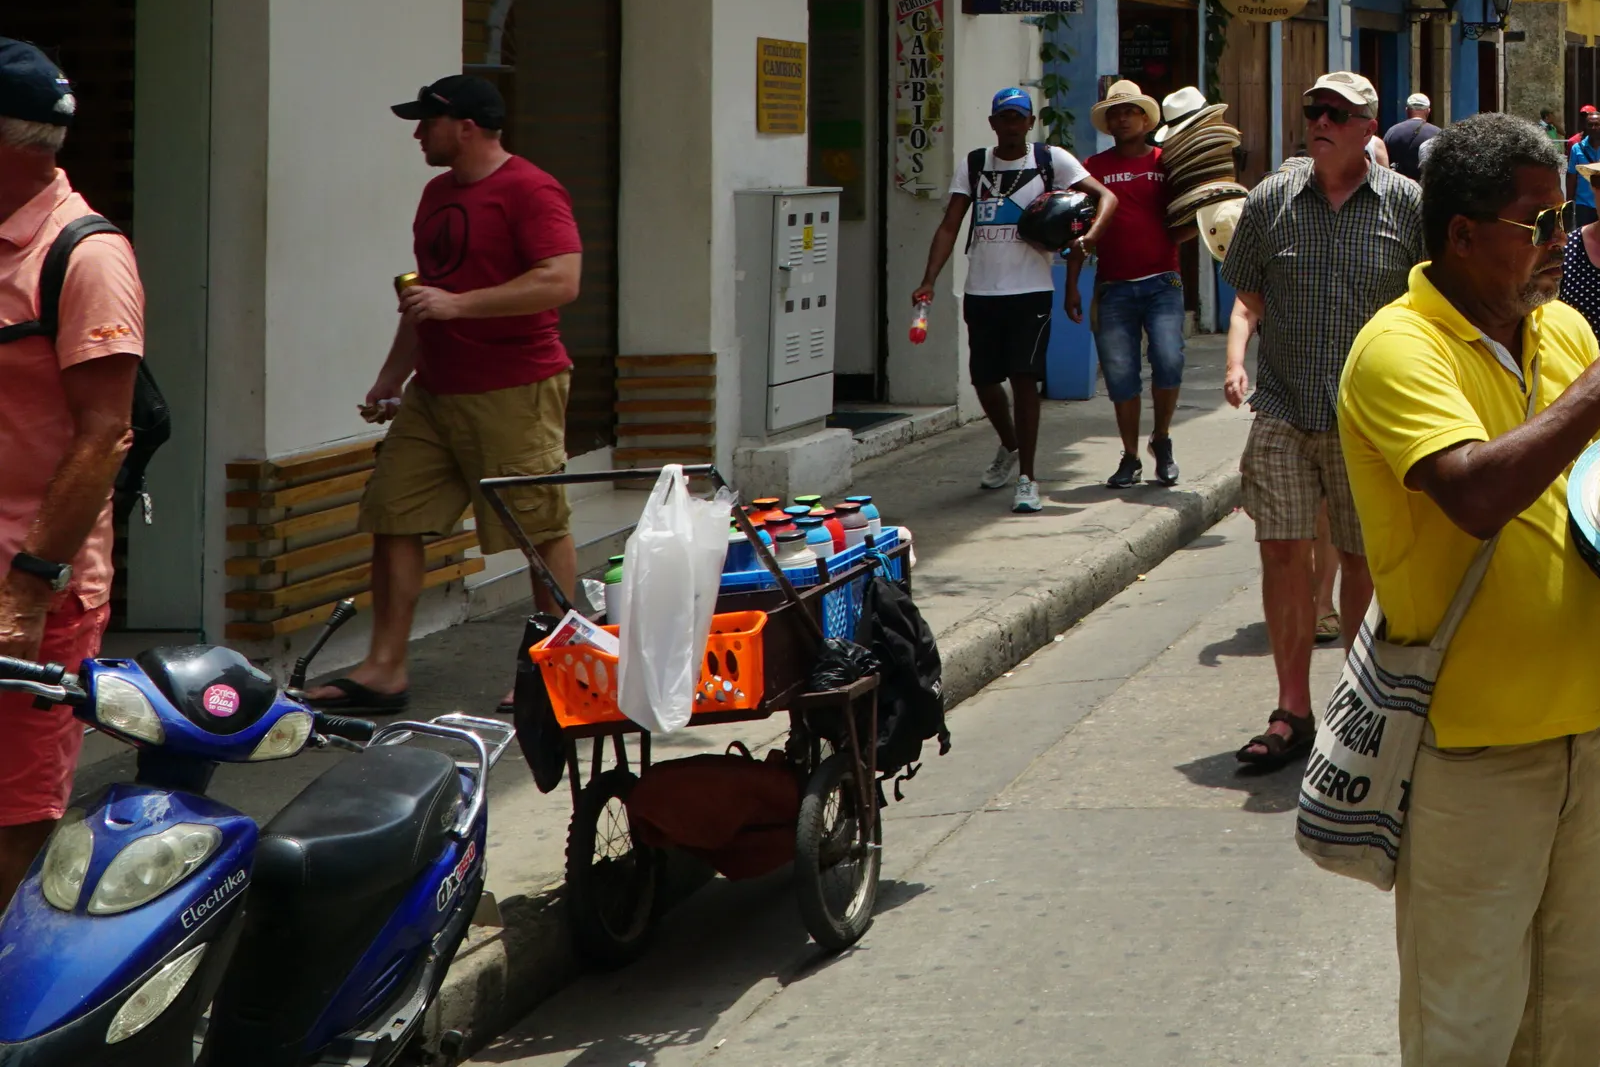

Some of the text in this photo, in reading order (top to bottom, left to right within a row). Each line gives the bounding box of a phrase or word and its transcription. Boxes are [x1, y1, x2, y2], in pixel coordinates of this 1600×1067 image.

[1006, 0, 1077, 13] EXCHANGE
[763, 59, 803, 78] CAMBIOS
[909, 11, 928, 174] CAMBIOS
[1103, 171, 1165, 184] NIKE FIT
[208, 694, 234, 708] Dios
[180, 868, 246, 929] Electrika
